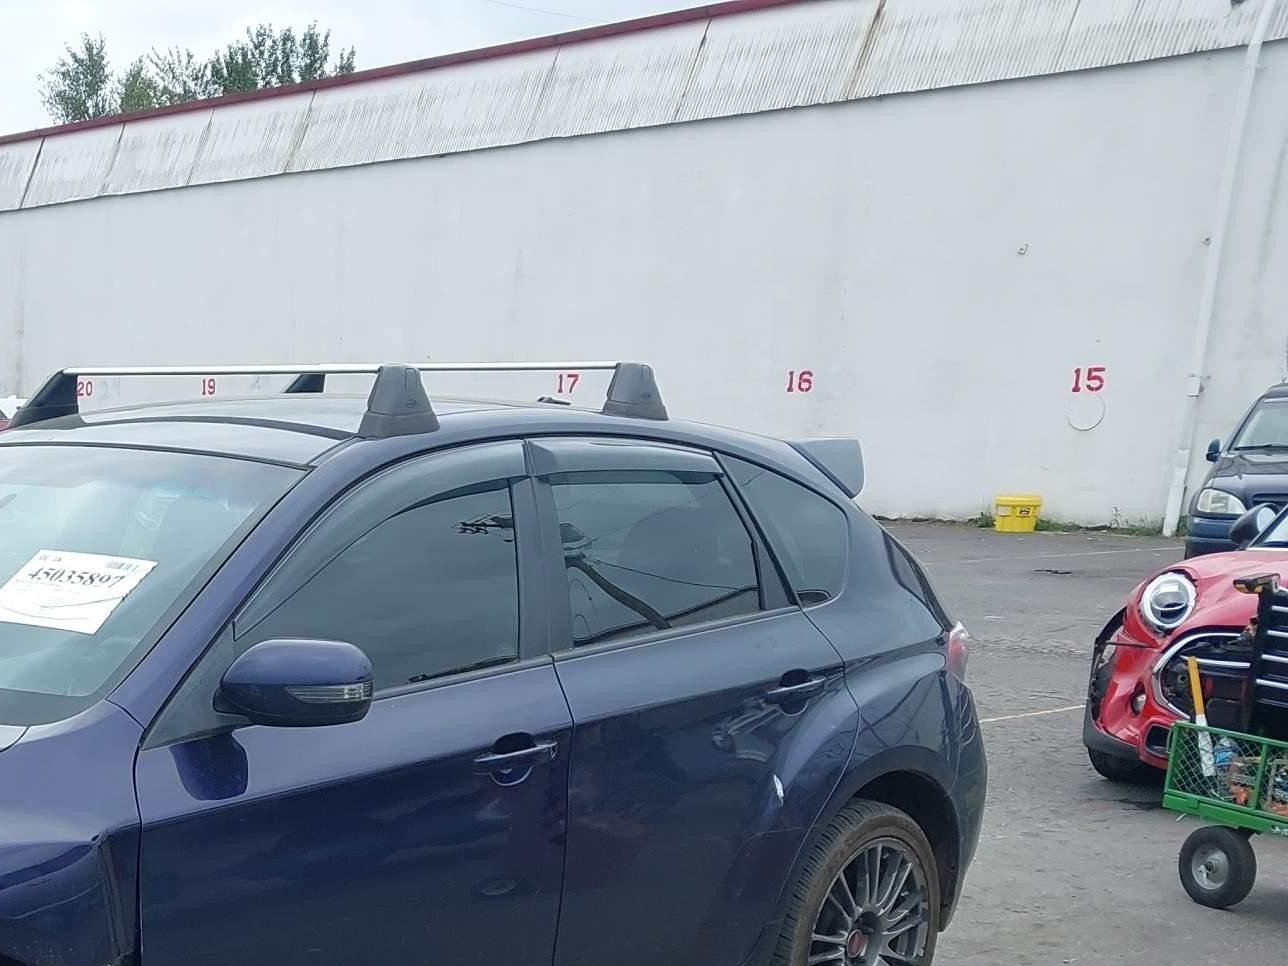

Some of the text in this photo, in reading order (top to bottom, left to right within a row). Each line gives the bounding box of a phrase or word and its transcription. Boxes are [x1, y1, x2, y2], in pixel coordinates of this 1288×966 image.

[77, 381, 93, 396] 20
[201, 378, 216, 395] 19
[557, 373, 579, 394] 17
[786, 370, 814, 392] 16
[1071, 367, 1106, 392] 15
[28, 567, 126, 588] 45035897
